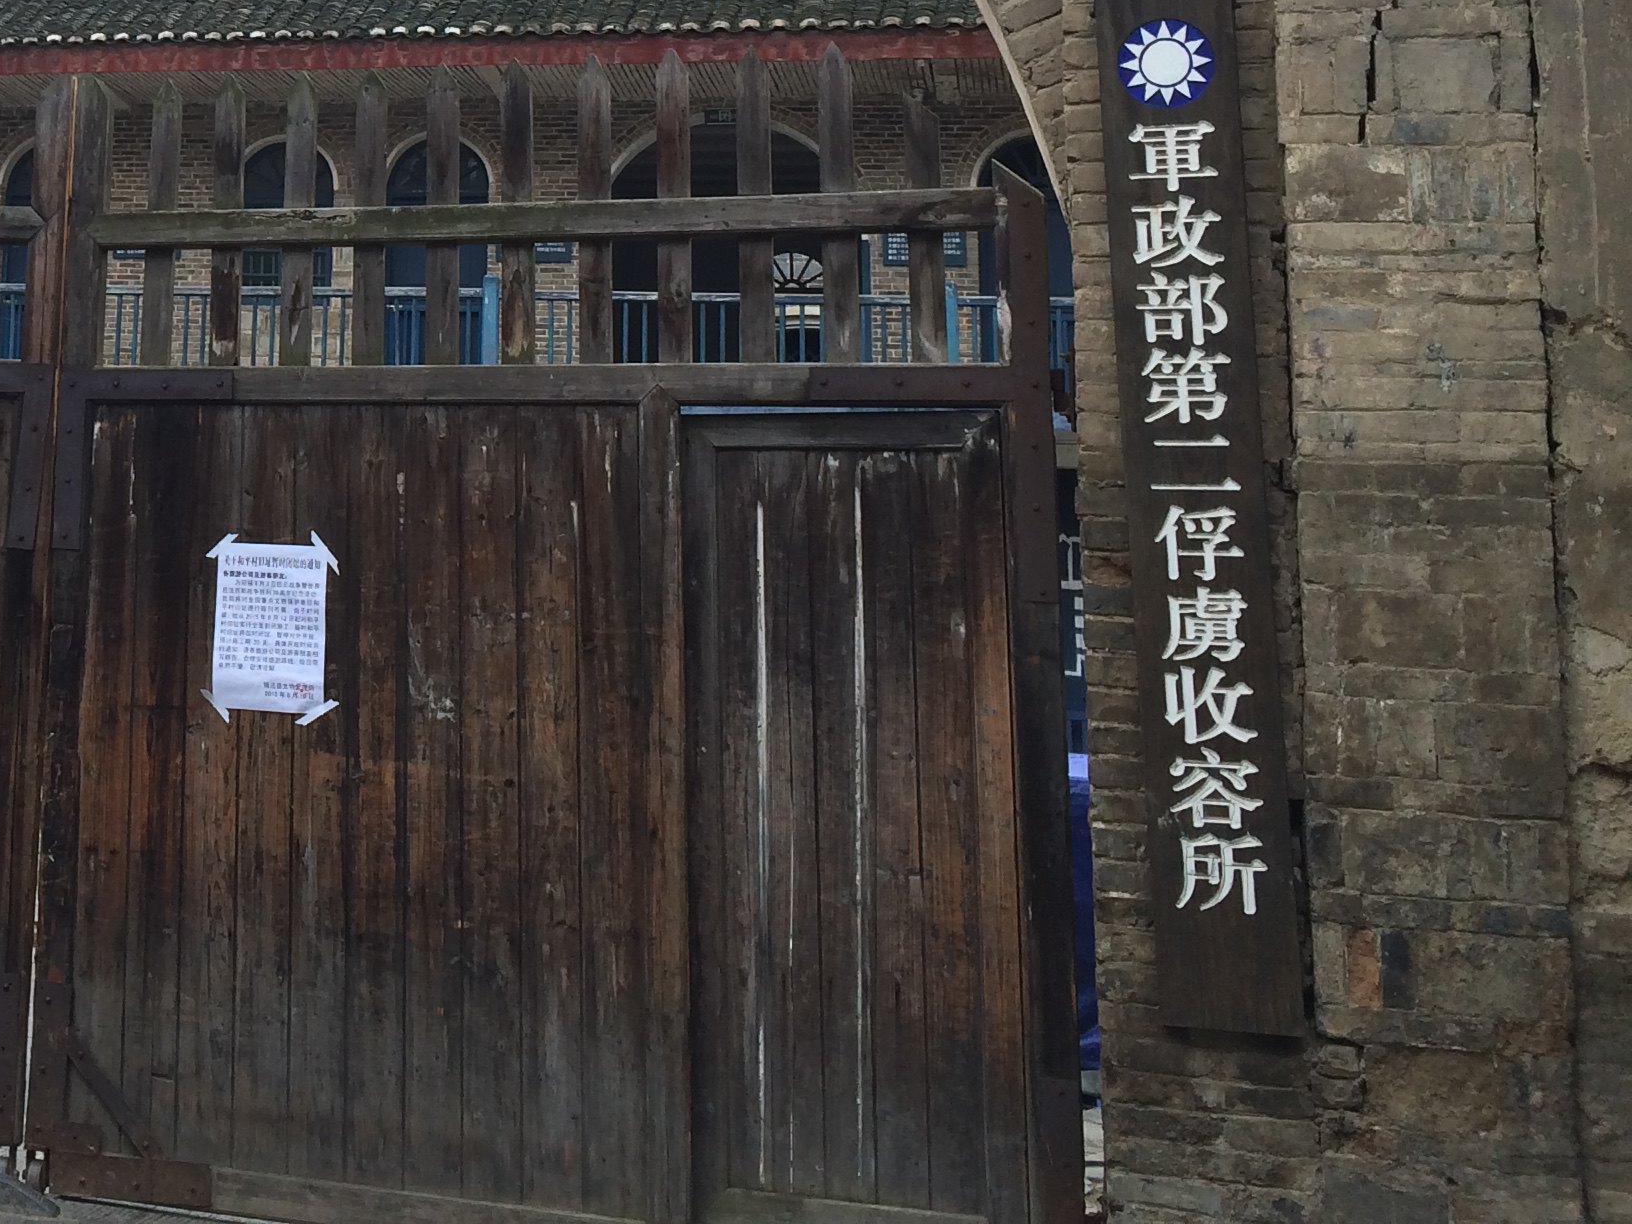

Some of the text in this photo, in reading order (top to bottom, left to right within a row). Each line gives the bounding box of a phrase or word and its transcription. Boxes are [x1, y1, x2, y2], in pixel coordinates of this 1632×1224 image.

[1126, 119, 1269, 917] 軍政部第二俘虜收容所
